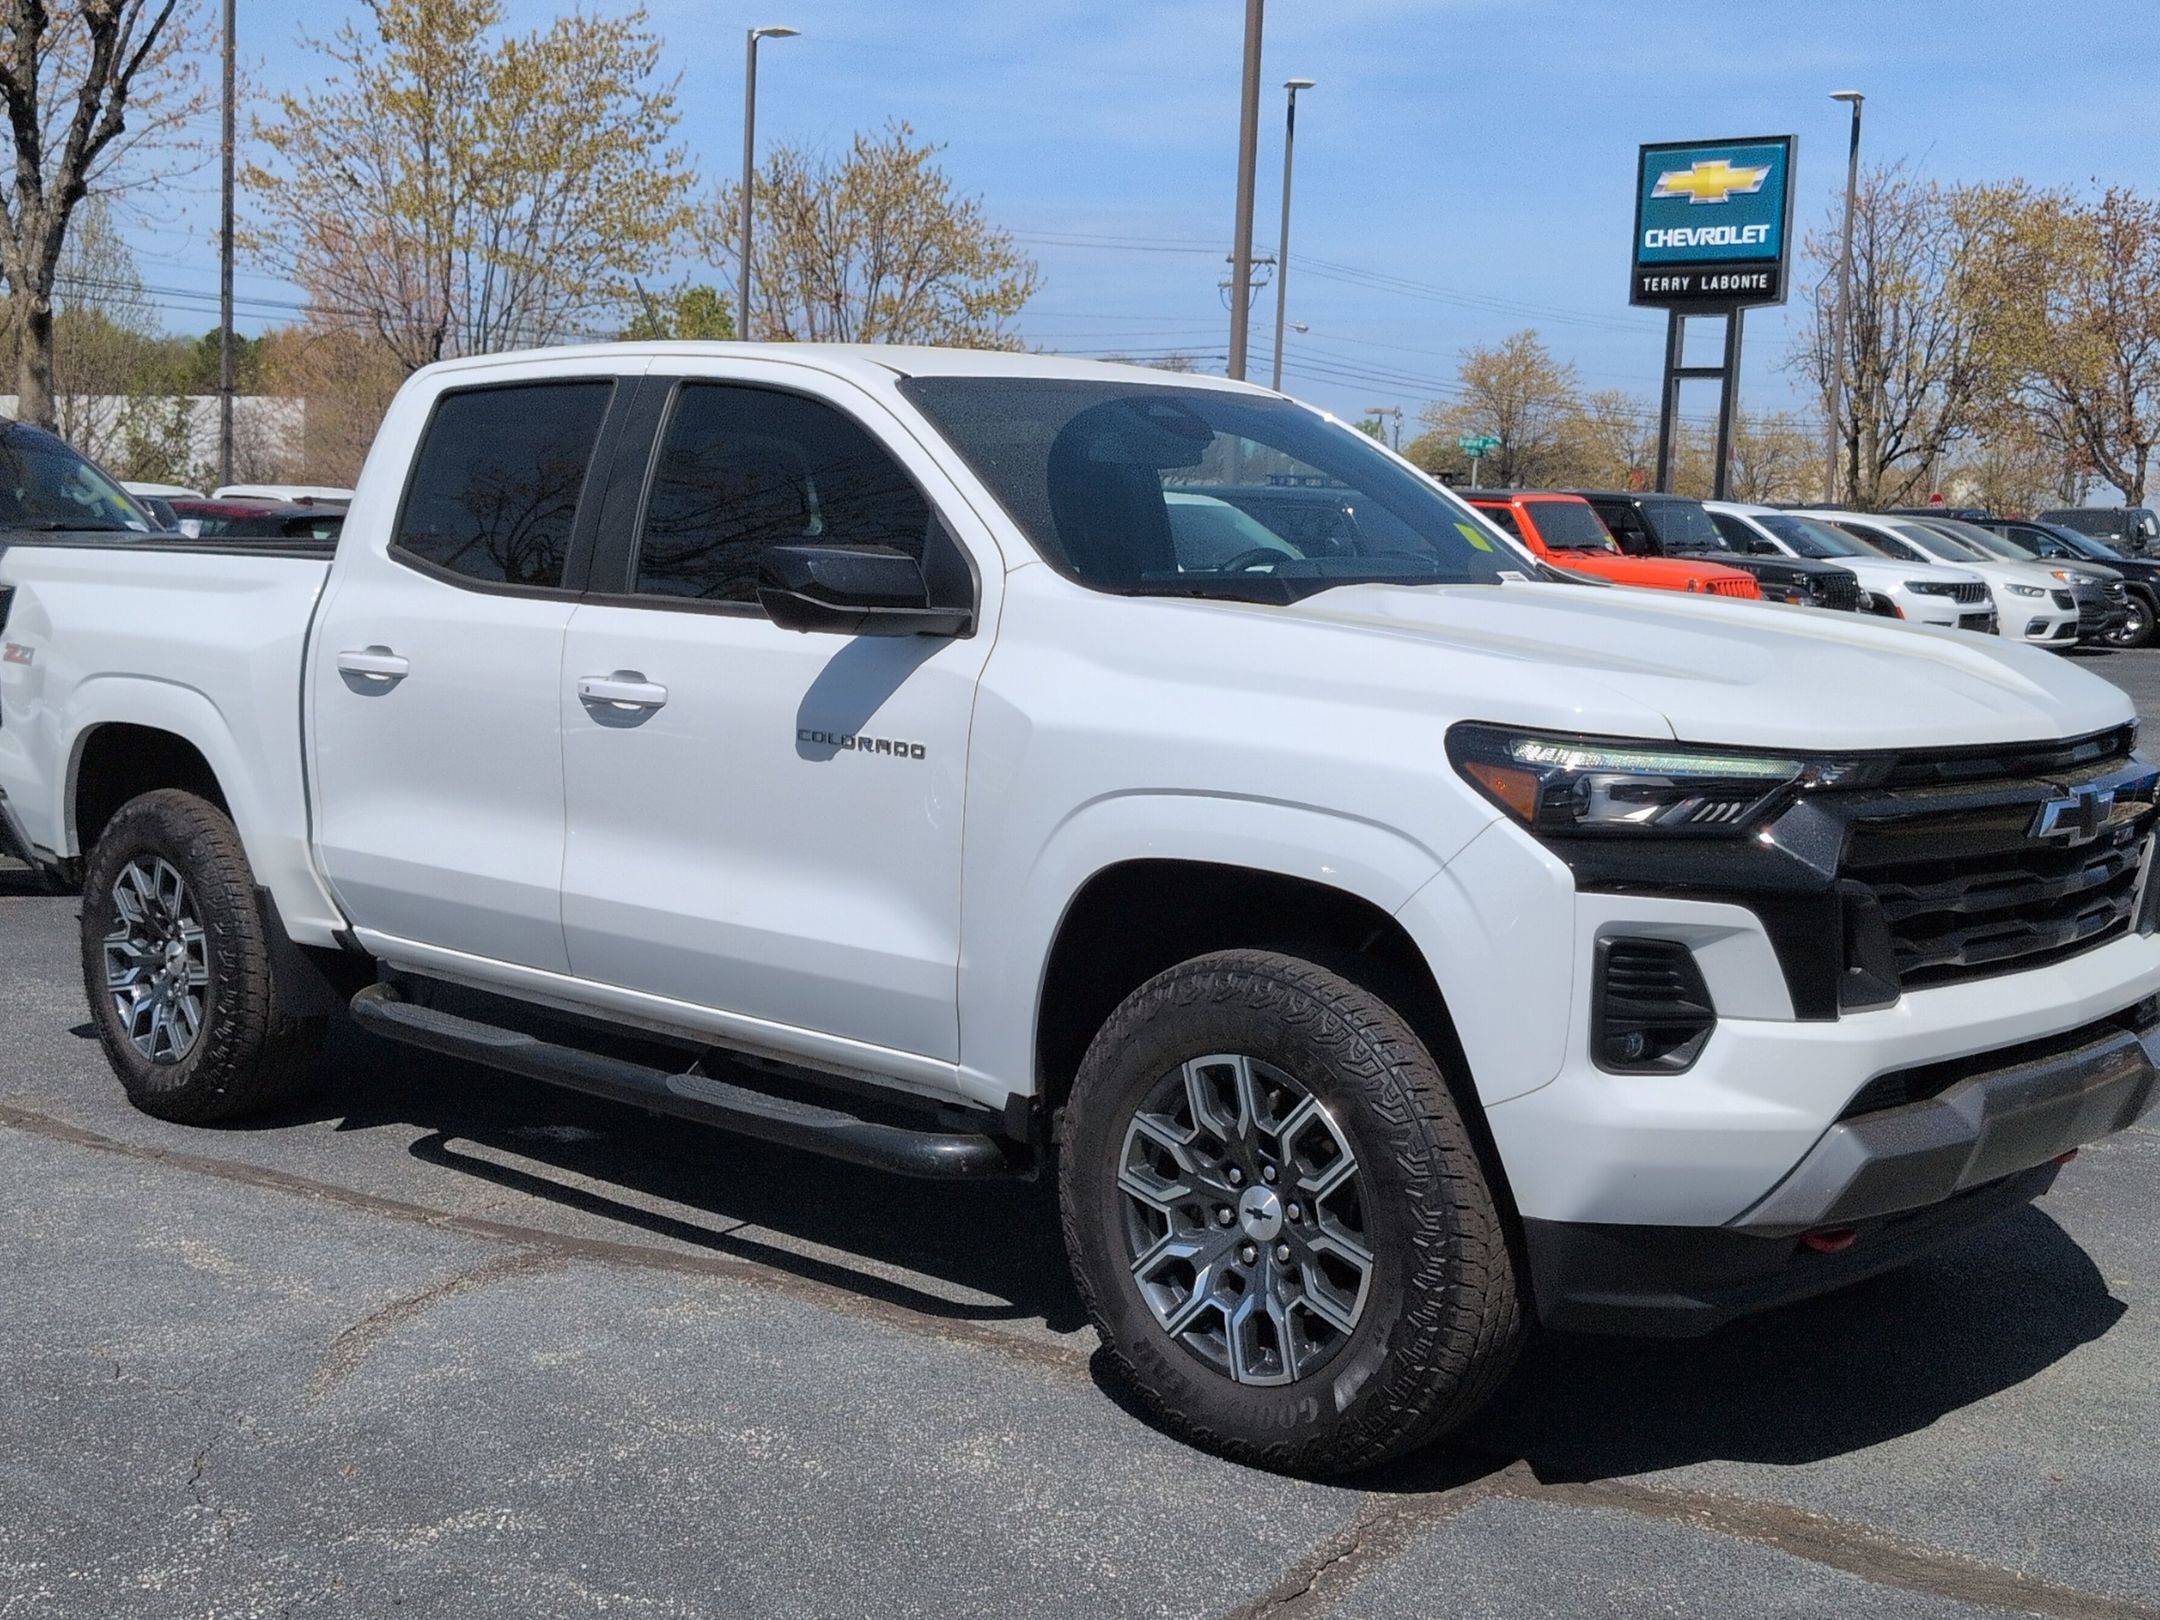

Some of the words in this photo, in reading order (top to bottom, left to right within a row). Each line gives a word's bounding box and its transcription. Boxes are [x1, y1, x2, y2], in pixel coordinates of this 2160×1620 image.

[1645, 224, 1770, 248] CHEVROLET
[1643, 276, 1691, 292] TERRY
[1701, 274, 1768, 290] LABONTE
[797, 729, 926, 760] COLORADO
